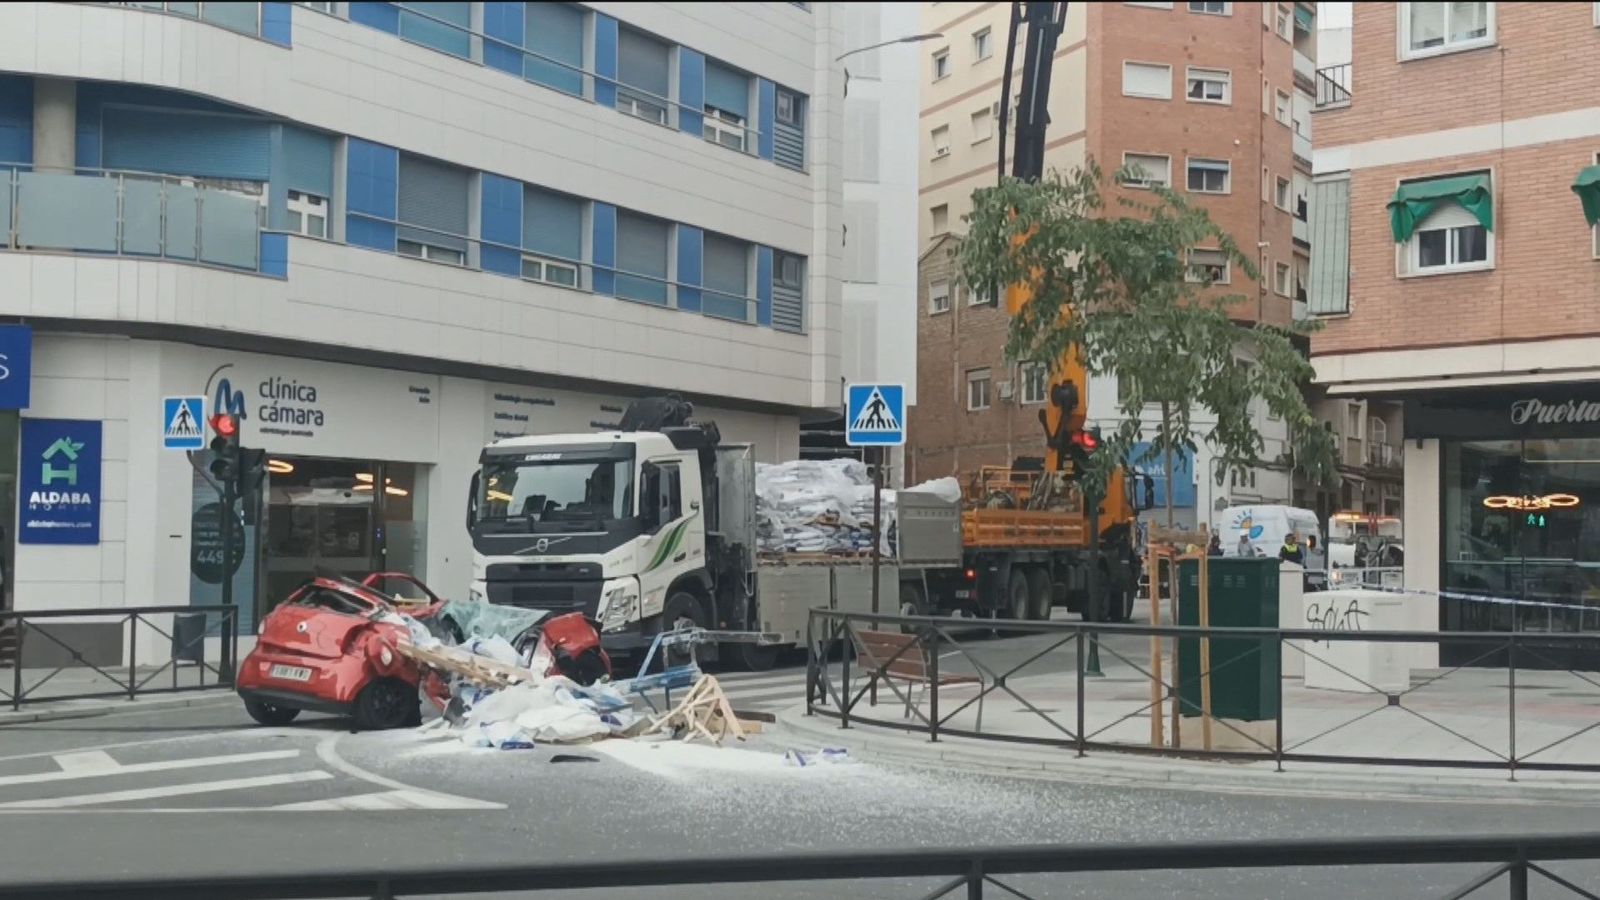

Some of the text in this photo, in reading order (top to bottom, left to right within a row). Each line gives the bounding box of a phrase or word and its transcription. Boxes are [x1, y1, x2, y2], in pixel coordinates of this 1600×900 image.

[259, 377, 317, 402] clínica
[259, 400, 324, 426] cámara
[30, 492, 91, 504] ALDABA
